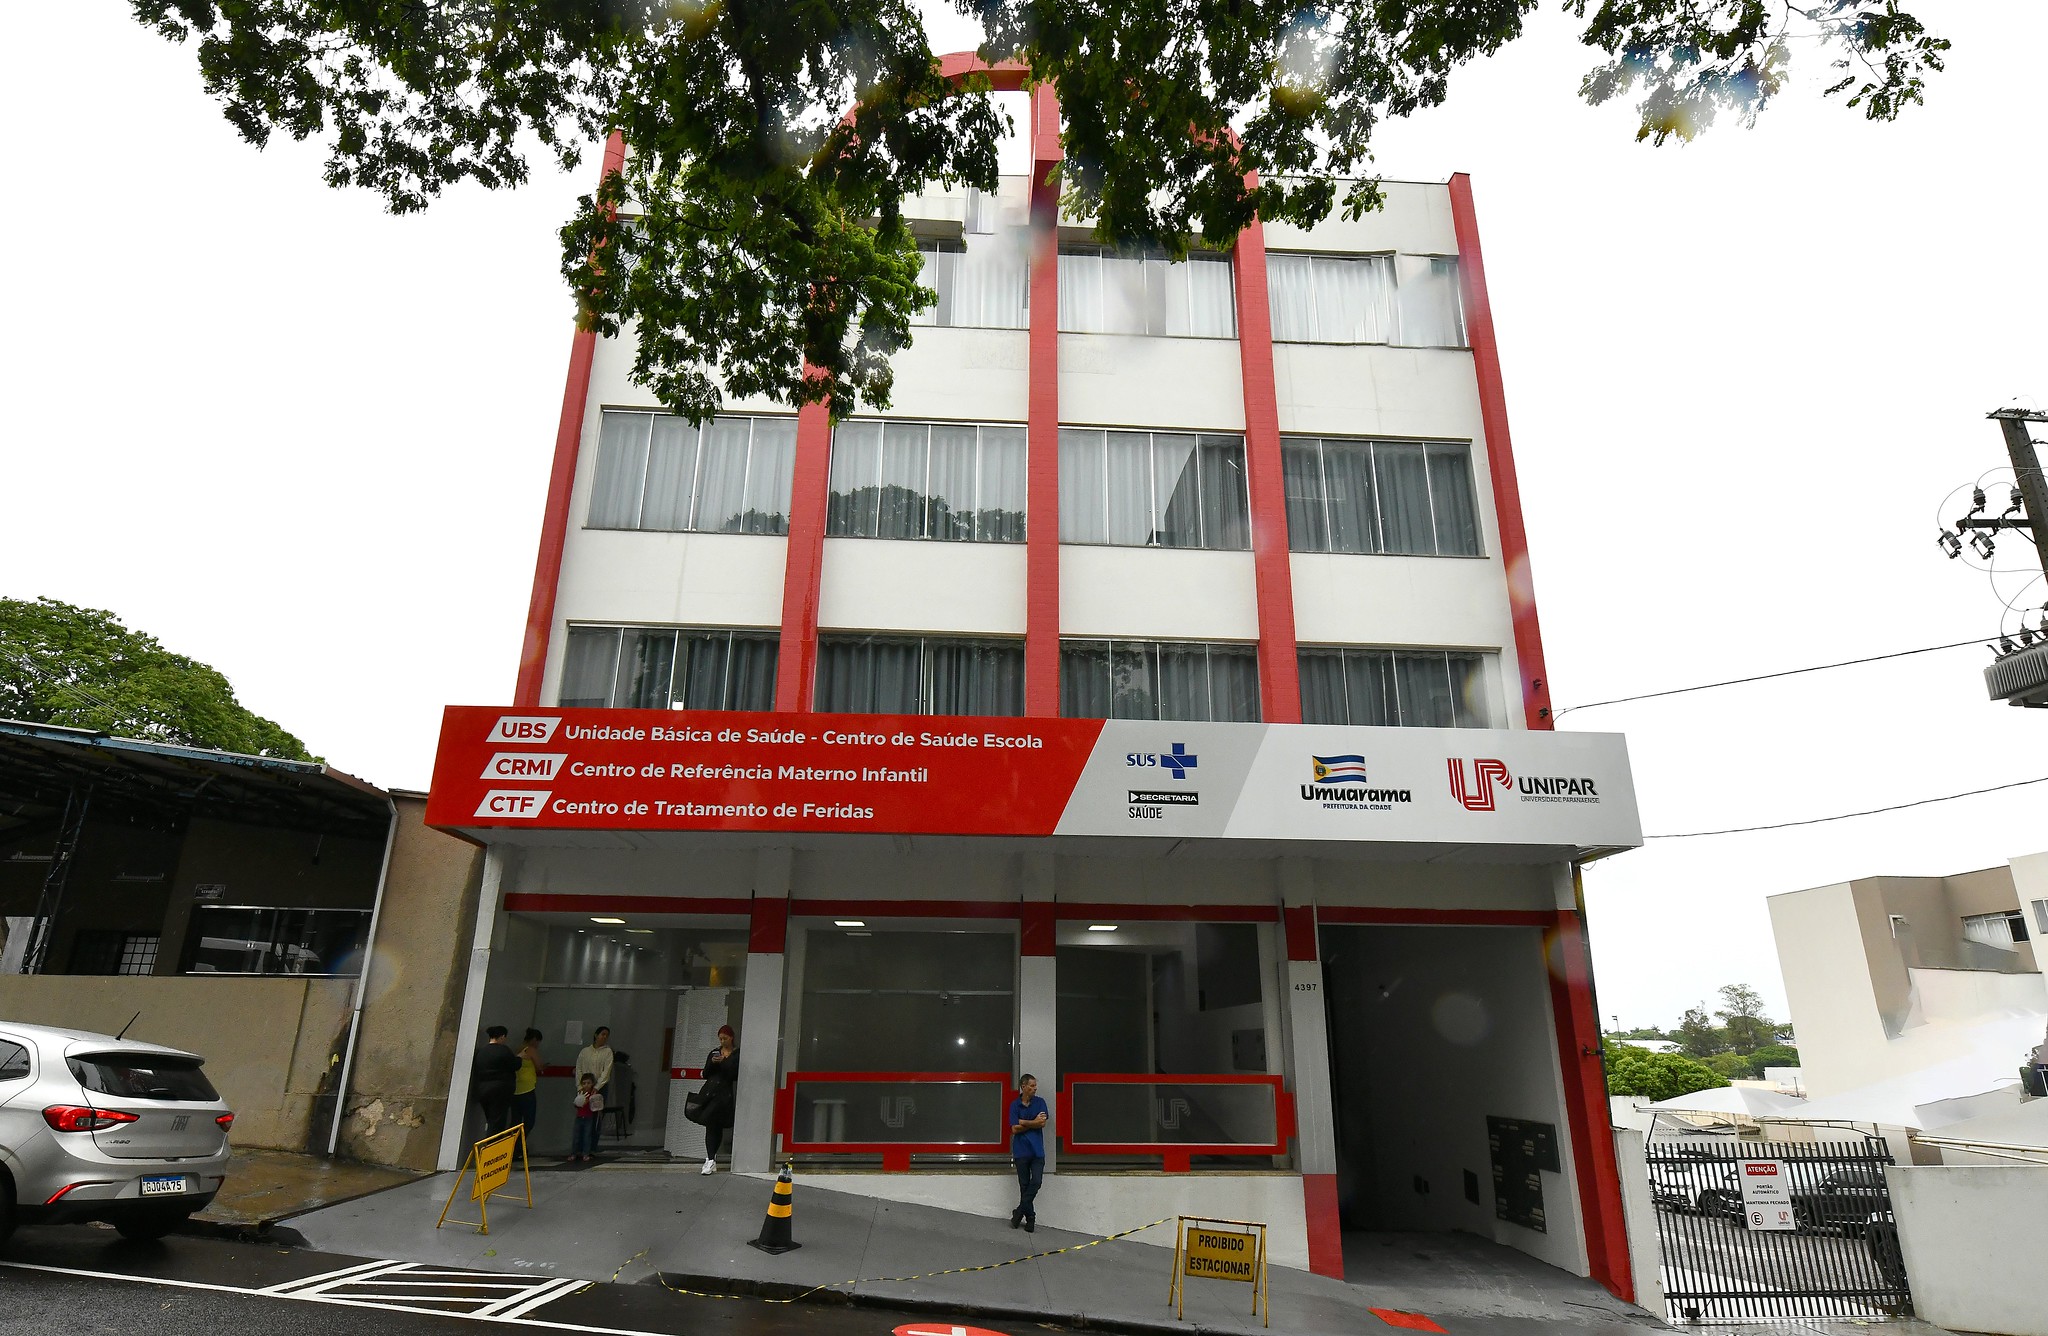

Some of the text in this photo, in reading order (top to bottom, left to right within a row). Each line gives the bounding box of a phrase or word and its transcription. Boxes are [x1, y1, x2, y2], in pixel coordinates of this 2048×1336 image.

[501, 722, 547, 739] UBS
[565, 725, 646, 742] Unidade
[651, 726, 711, 742] Básica
[717, 727, 741, 743] de
[746, 728, 806, 744] Saúde
[822, 730, 886, 746] Centro
[891, 731, 915, 747] de
[920, 732, 978, 748] Saúde
[983, 733, 1043, 749] Escola
[495, 759, 552, 776] CRMI
[1126, 753, 1157, 767] SUS
[570, 762, 928, 782] Centro de Referência Materno Infantil
[1300, 784, 1412, 803] Umuarama
[1518, 776, 1600, 796] UNIPAR
[489, 796, 535, 813] CTF
[1139, 794, 1197, 803] SECRETARIA
[1520, 795, 1600, 804] UNIVERSIDADE PARANAENSE
[552, 799, 874, 819] Centro de Tratamento de Feridas
[1129, 805, 1163, 819] SAÚDE
[1294, 983, 1317, 991] 4397
[483, 1153, 508, 1168] PROIBIDO
[478, 1163, 508, 1182] STACIONAR
[1747, 1165, 1776, 1174] ATENÇÃO
[1198, 1234, 1244, 1252] PROIBIDO
[1190, 1257, 1250, 1276] ESTACIONAR
